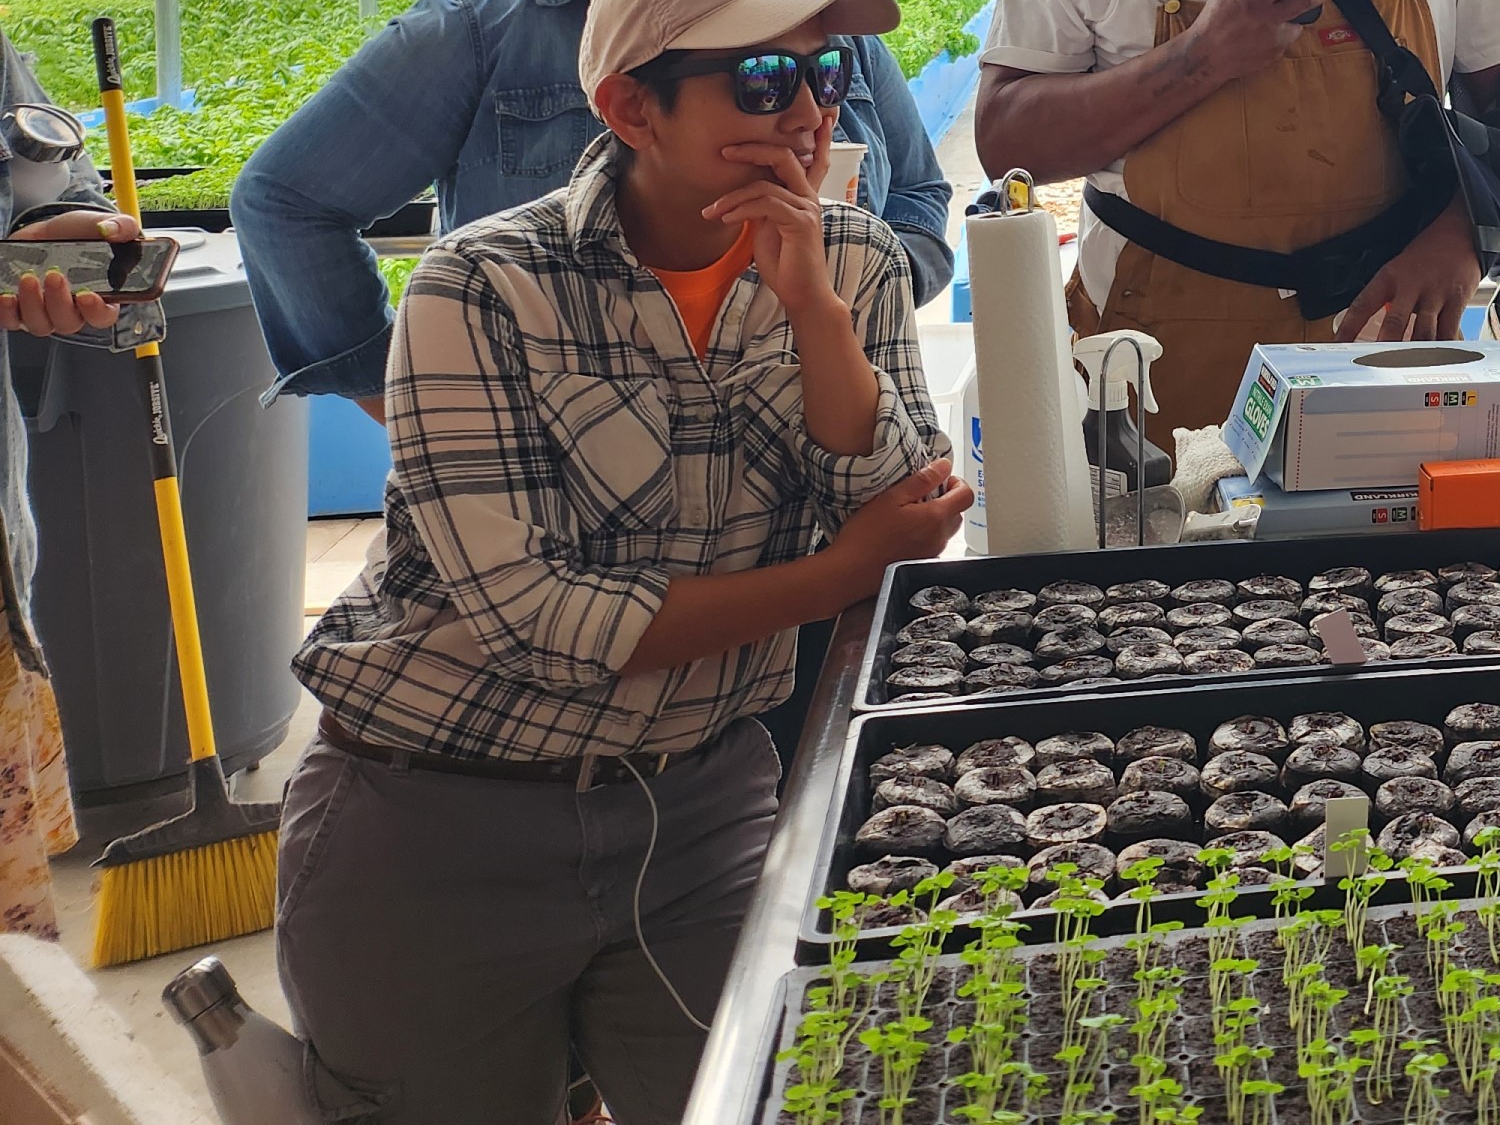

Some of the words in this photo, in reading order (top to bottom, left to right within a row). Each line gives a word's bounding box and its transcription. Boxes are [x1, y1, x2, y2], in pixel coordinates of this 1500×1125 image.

[1450, 395, 1457, 403] M
[1245, 397, 1270, 438] GLOVES
[1354, 492, 1418, 500] KIRKLAND
